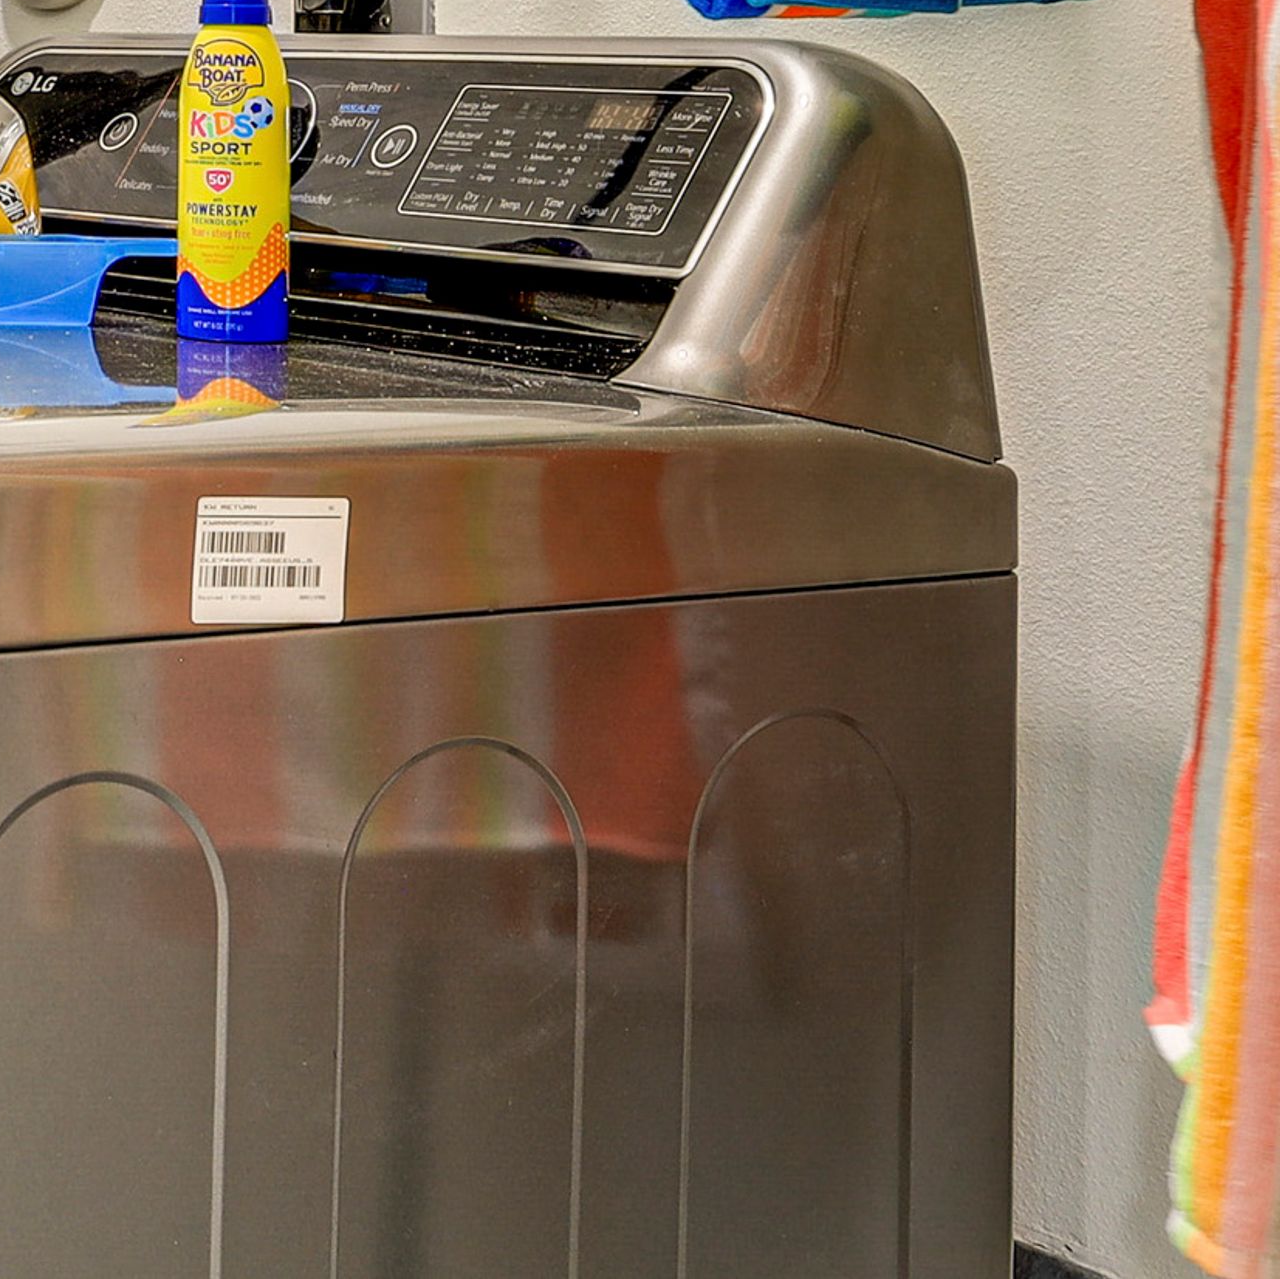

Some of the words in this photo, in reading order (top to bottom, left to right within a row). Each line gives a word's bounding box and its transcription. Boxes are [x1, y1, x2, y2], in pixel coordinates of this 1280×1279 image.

[194, 48, 256, 68] BANANA
[31, 75, 58, 92] LG
[200, 68, 244, 88] BOAT
[368, 82, 392, 94] Press
[329, 115, 356, 129] Speed
[356, 118, 373, 131] Dry
[672, 112, 695, 122] More
[191, 142, 252, 155] SPORT
[656, 144, 674, 153] Less
[675, 145, 695, 158] Time
[321, 154, 335, 165] Air
[336, 155, 352, 168] Dry
[426, 161, 445, 170] Drum
[446, 163, 463, 173] Light
[648, 170, 677, 179] Wrinkle
[648, 178, 667, 186] Care
[463, 191, 480, 203] Dry
[544, 197, 565, 208] Time
[187, 203, 258, 217] POWERSTAY
[455, 202, 478, 213] Level
[580, 205, 609, 219] Signal
[625, 202, 648, 213] Damp
[648, 205, 664, 215] Dry
[540, 208, 557, 220] Dry
[628, 212, 652, 222] Signal
